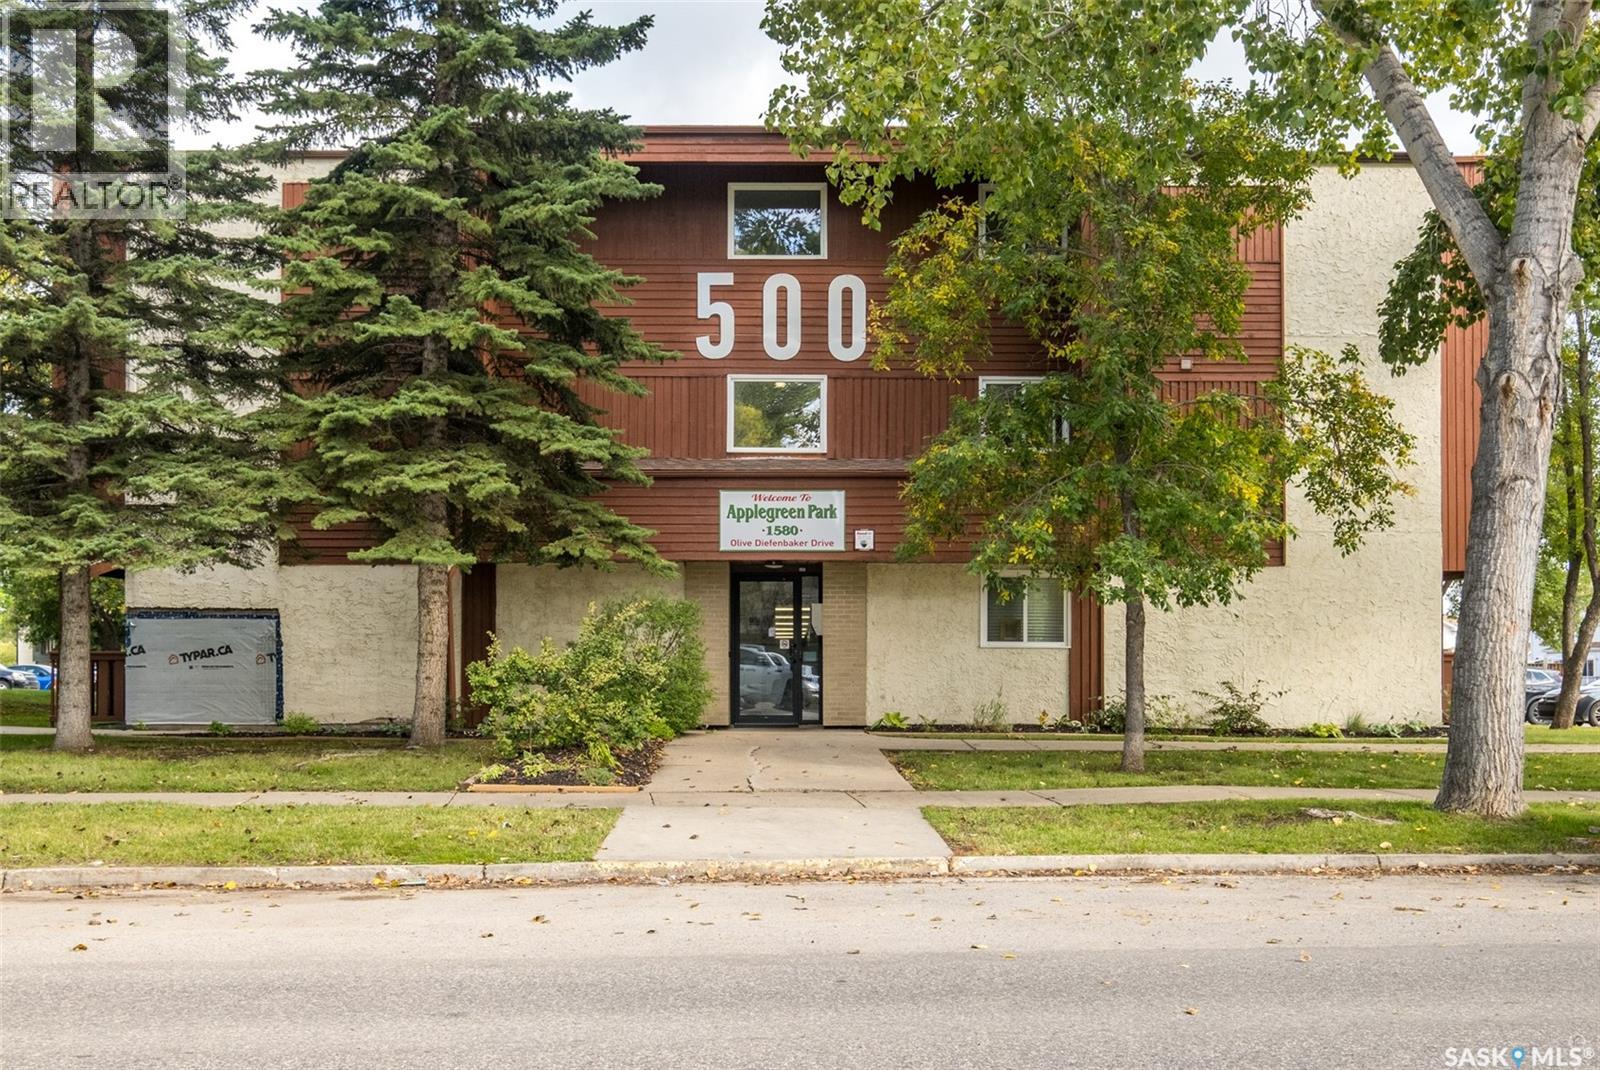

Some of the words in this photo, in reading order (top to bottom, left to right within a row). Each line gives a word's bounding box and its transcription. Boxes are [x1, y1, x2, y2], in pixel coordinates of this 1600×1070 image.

[695, 272, 867, 362] 500
[752, 493, 797, 502] Welcome
[800, 493, 812, 502] To
[727, 504, 805, 523] Applegreen
[808, 504, 838, 519] Park
[730, 539, 752, 547] Olive
[755, 538, 808, 547] Diefenbaker
[811, 539, 835, 547] Drive
[179, 645, 233, 662] TYPAR.CA
